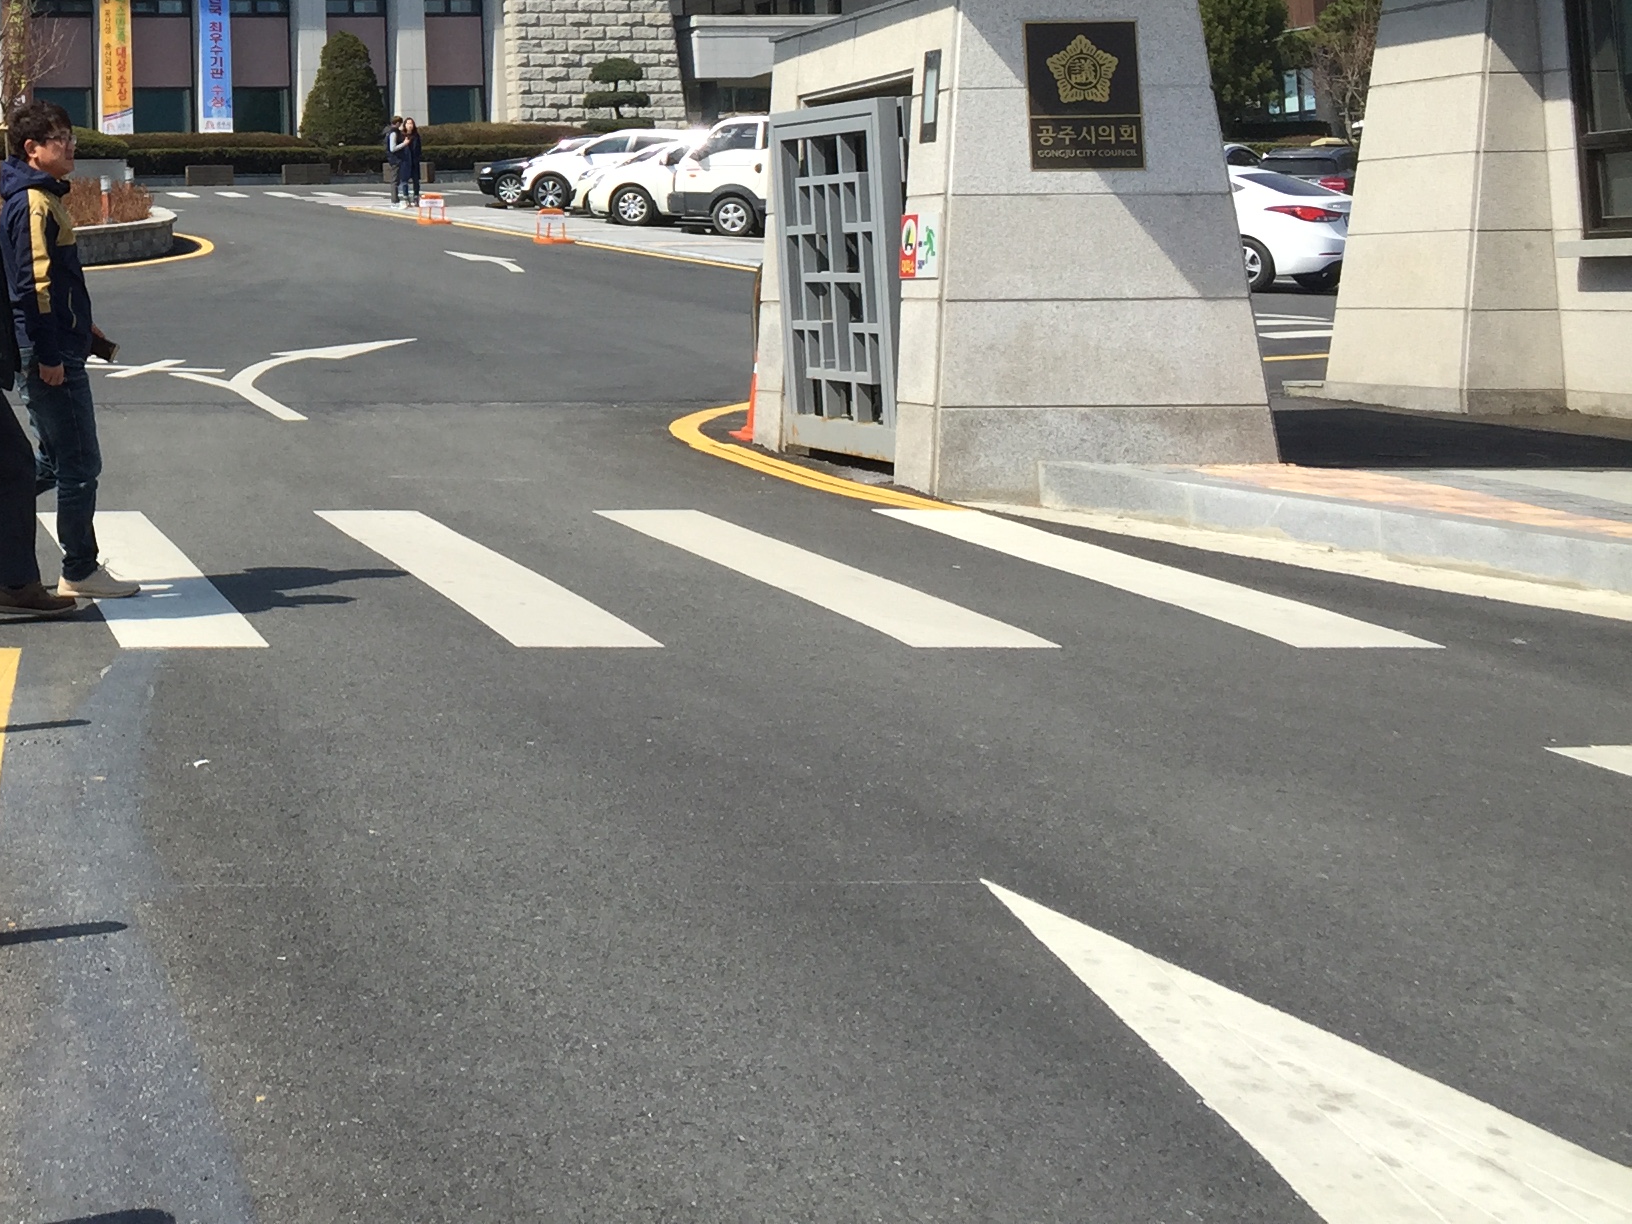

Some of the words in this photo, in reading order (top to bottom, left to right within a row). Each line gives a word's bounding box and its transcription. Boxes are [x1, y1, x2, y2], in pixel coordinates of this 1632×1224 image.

[116, 46, 127, 73] 대상
[209, 21, 224, 79] 최우수기관
[117, 76, 128, 102] 수상
[211, 85, 224, 108] 수상
[1036, 125, 1138, 146] 공주시의회
[1037, 149, 1076, 158] GONGJU
[1098, 149, 1137, 157] COUNCIL
